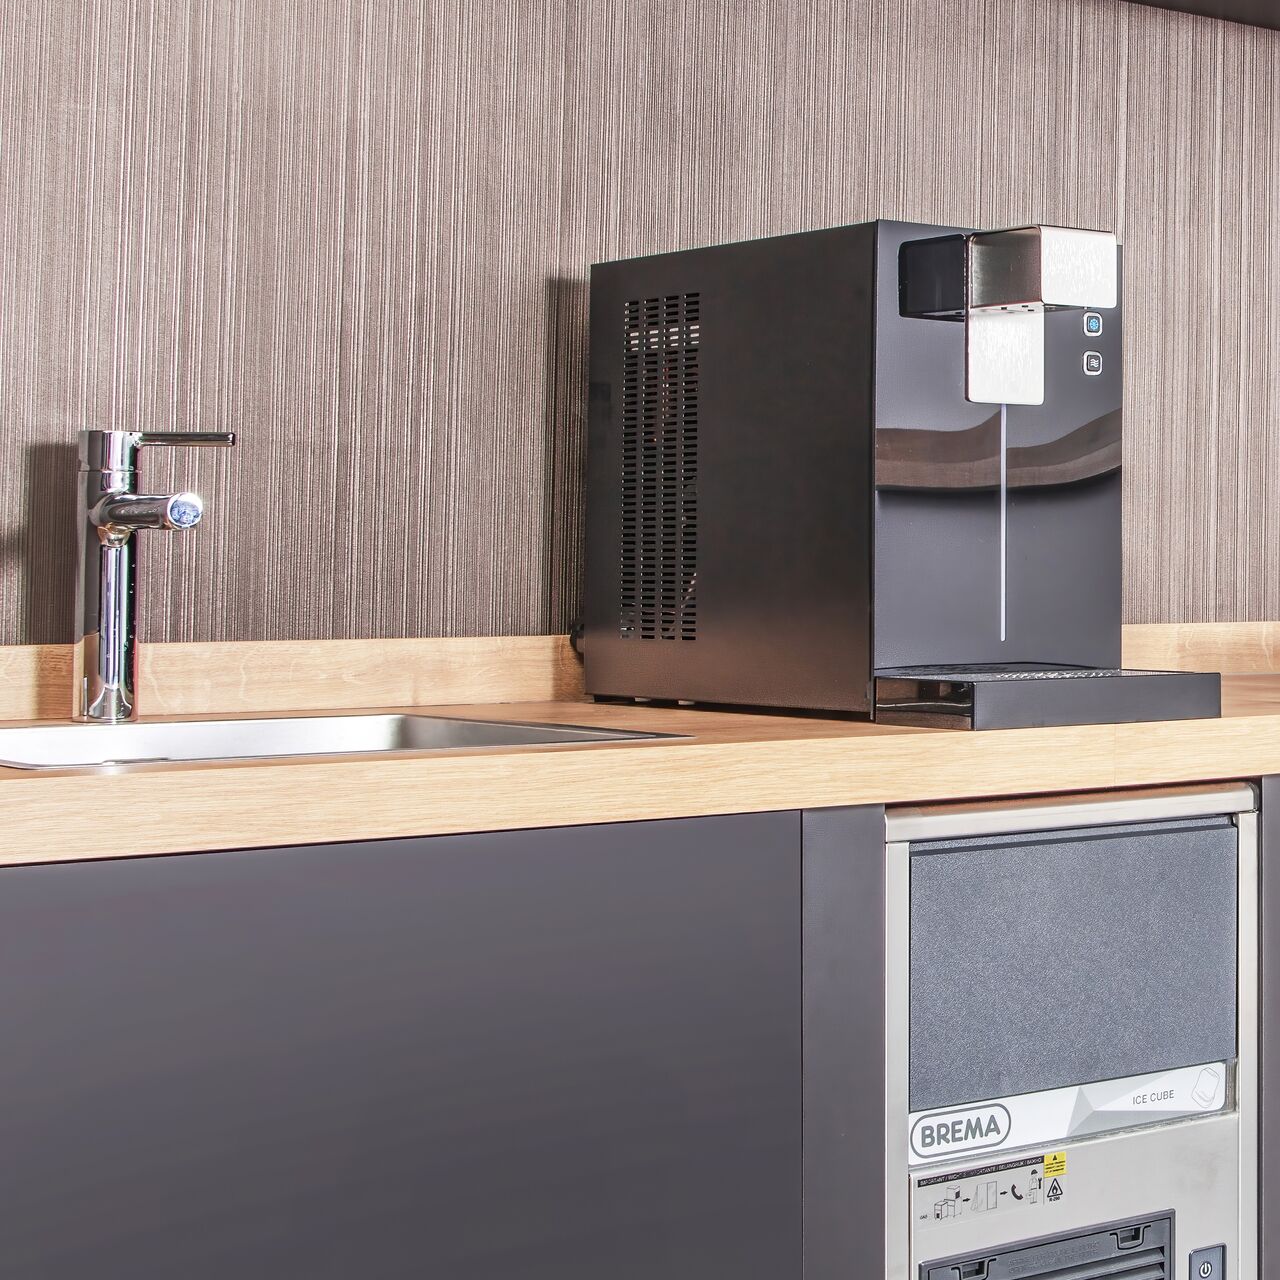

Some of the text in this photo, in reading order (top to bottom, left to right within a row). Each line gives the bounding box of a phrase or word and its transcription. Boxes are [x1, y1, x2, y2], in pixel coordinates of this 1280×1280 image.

[1133, 1090, 1174, 1105] ICE CUBE
[921, 1115, 1001, 1148] BREMA
